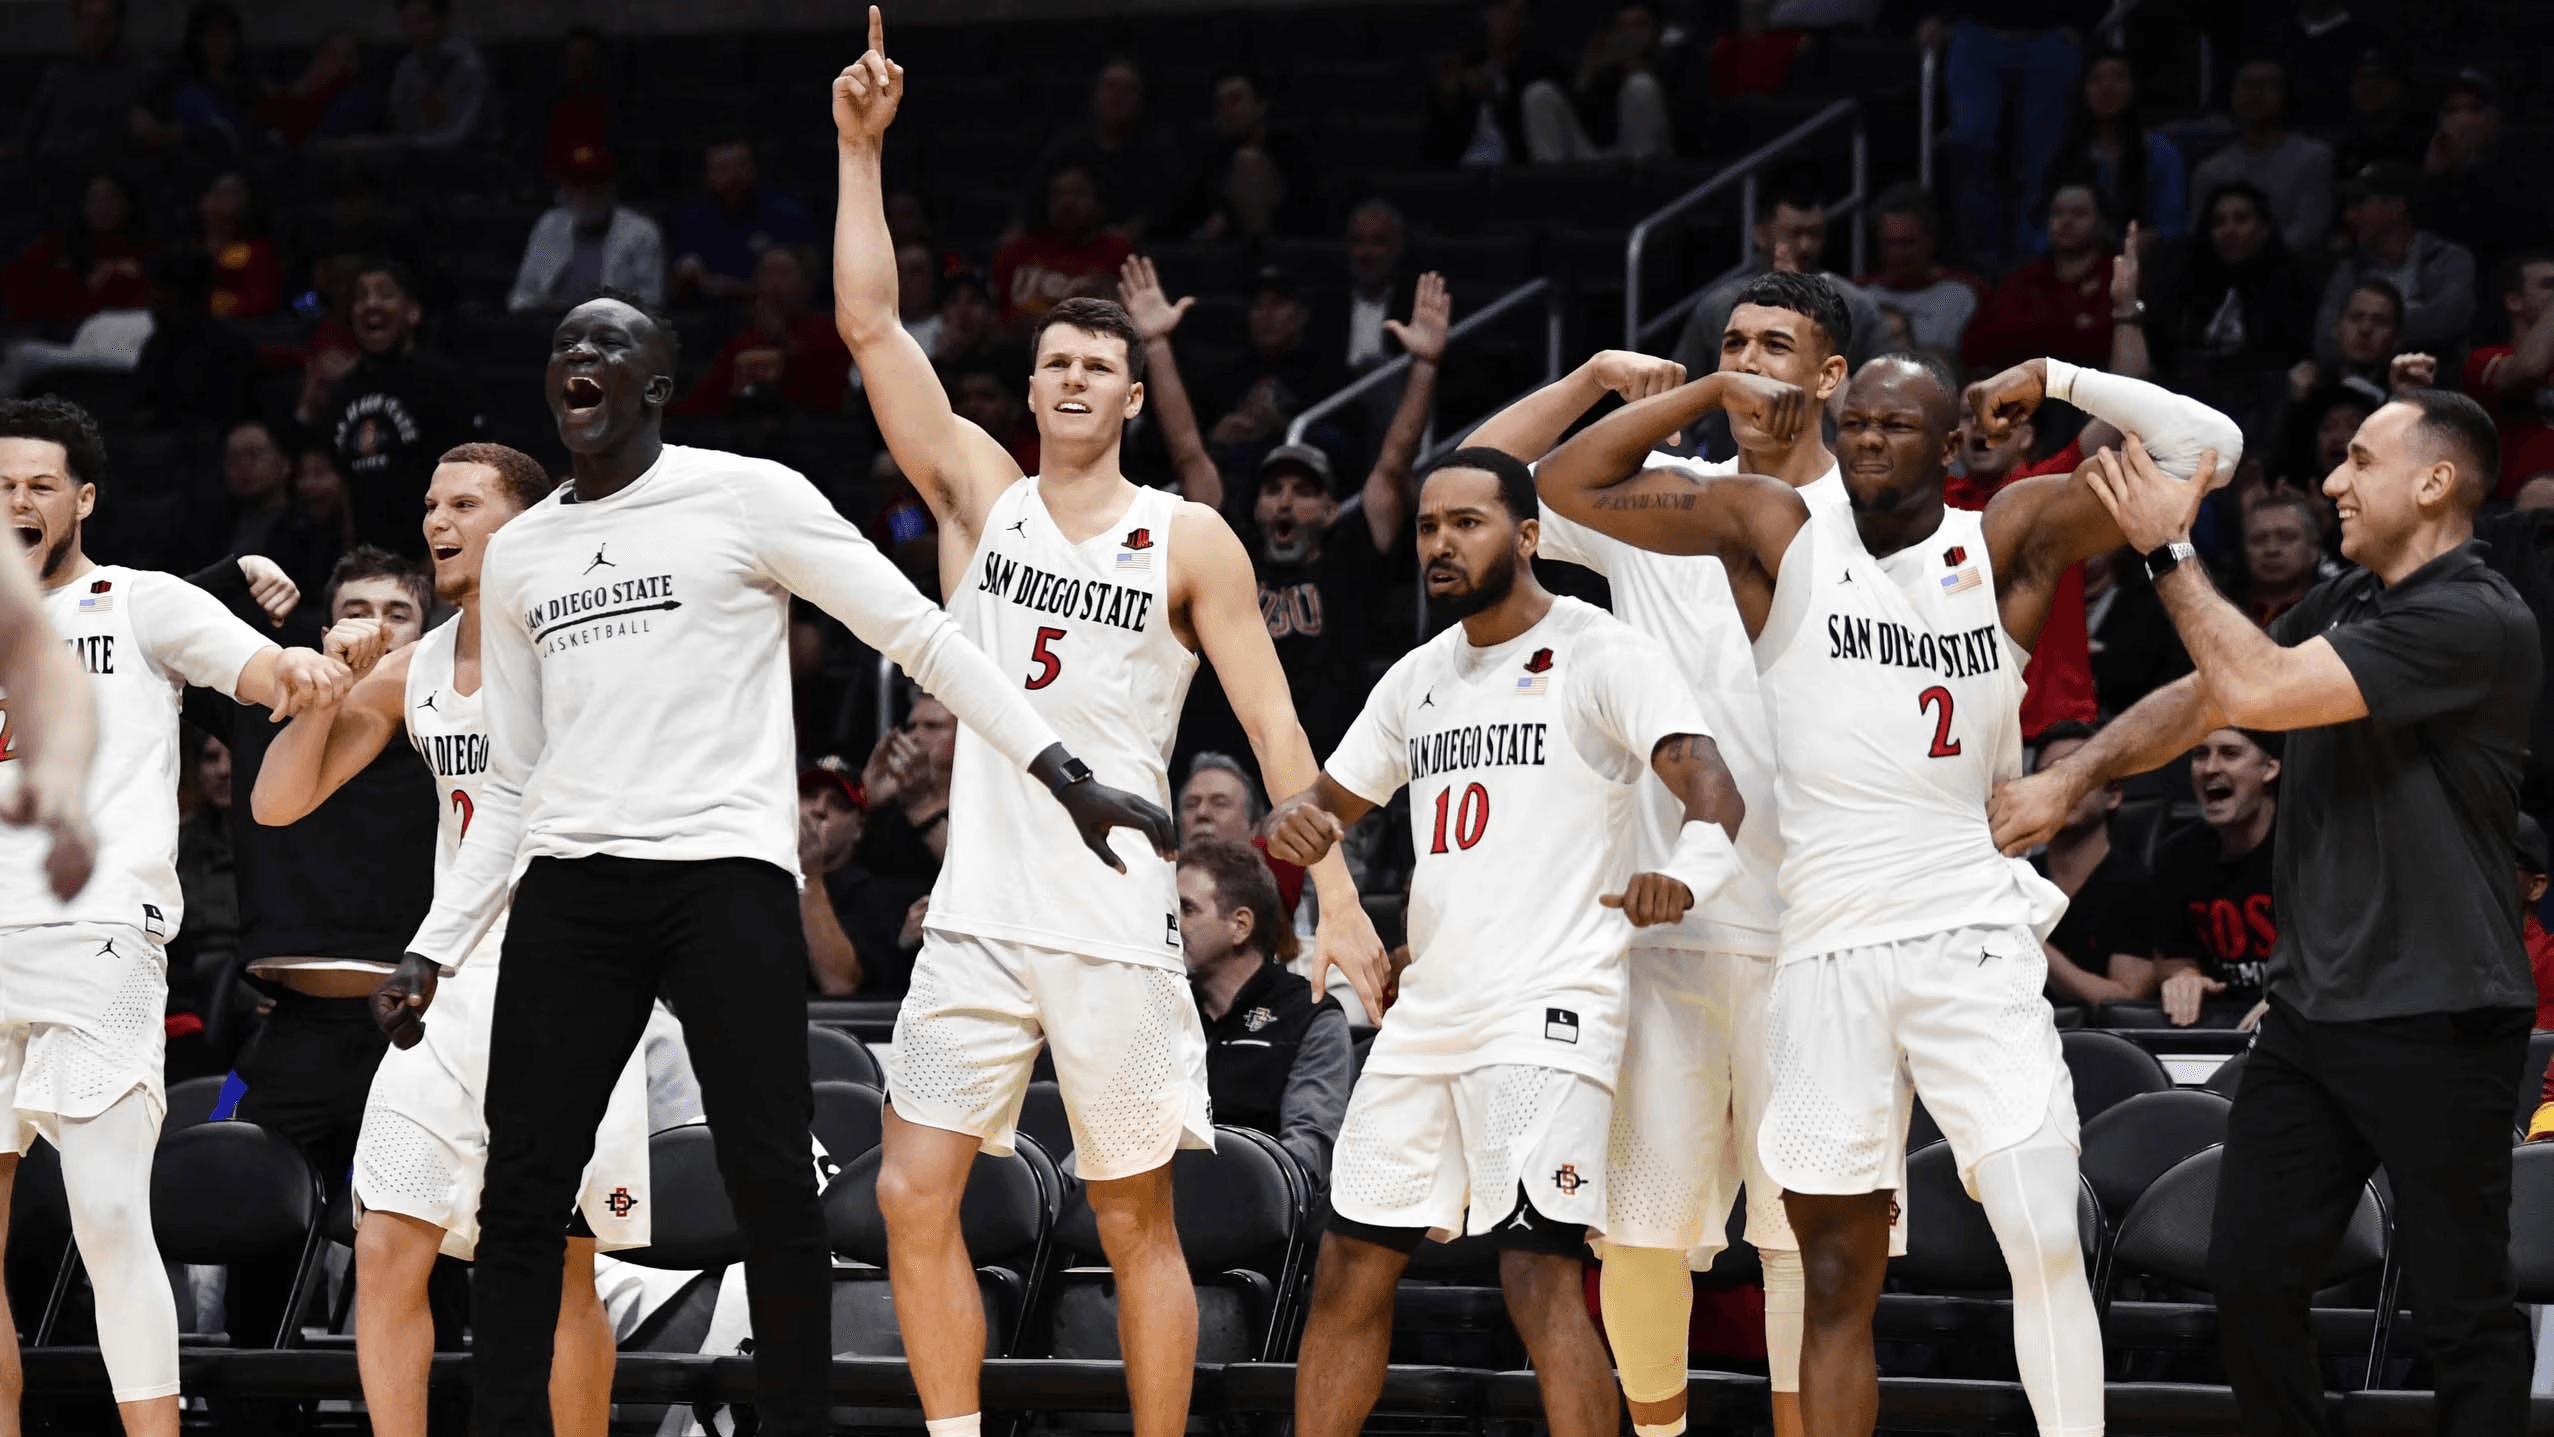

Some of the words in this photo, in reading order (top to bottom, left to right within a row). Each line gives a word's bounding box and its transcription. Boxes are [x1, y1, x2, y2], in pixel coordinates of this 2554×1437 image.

[549, 587, 607, 621] DIEGO
[612, 575, 673, 604] STATE
[978, 551, 1018, 598] SAN
[1012, 565, 1080, 618] DIEGO
[1080, 580, 1153, 632] STATE
[65, 635, 114, 674] ATE
[544, 619, 650, 658] ASKETBALL
[1025, 626, 1067, 690] 5
[1827, 614, 1872, 660] SAN
[1938, 624, 1999, 678] STATE
[1409, 734, 1431, 781] SAN
[1431, 725, 1482, 774] DIEGO
[1484, 723, 1547, 767] STATE
[1919, 685, 1961, 758] 2
[434, 733, 489, 776] DIEGO
[1430, 782, 1490, 855] 10
